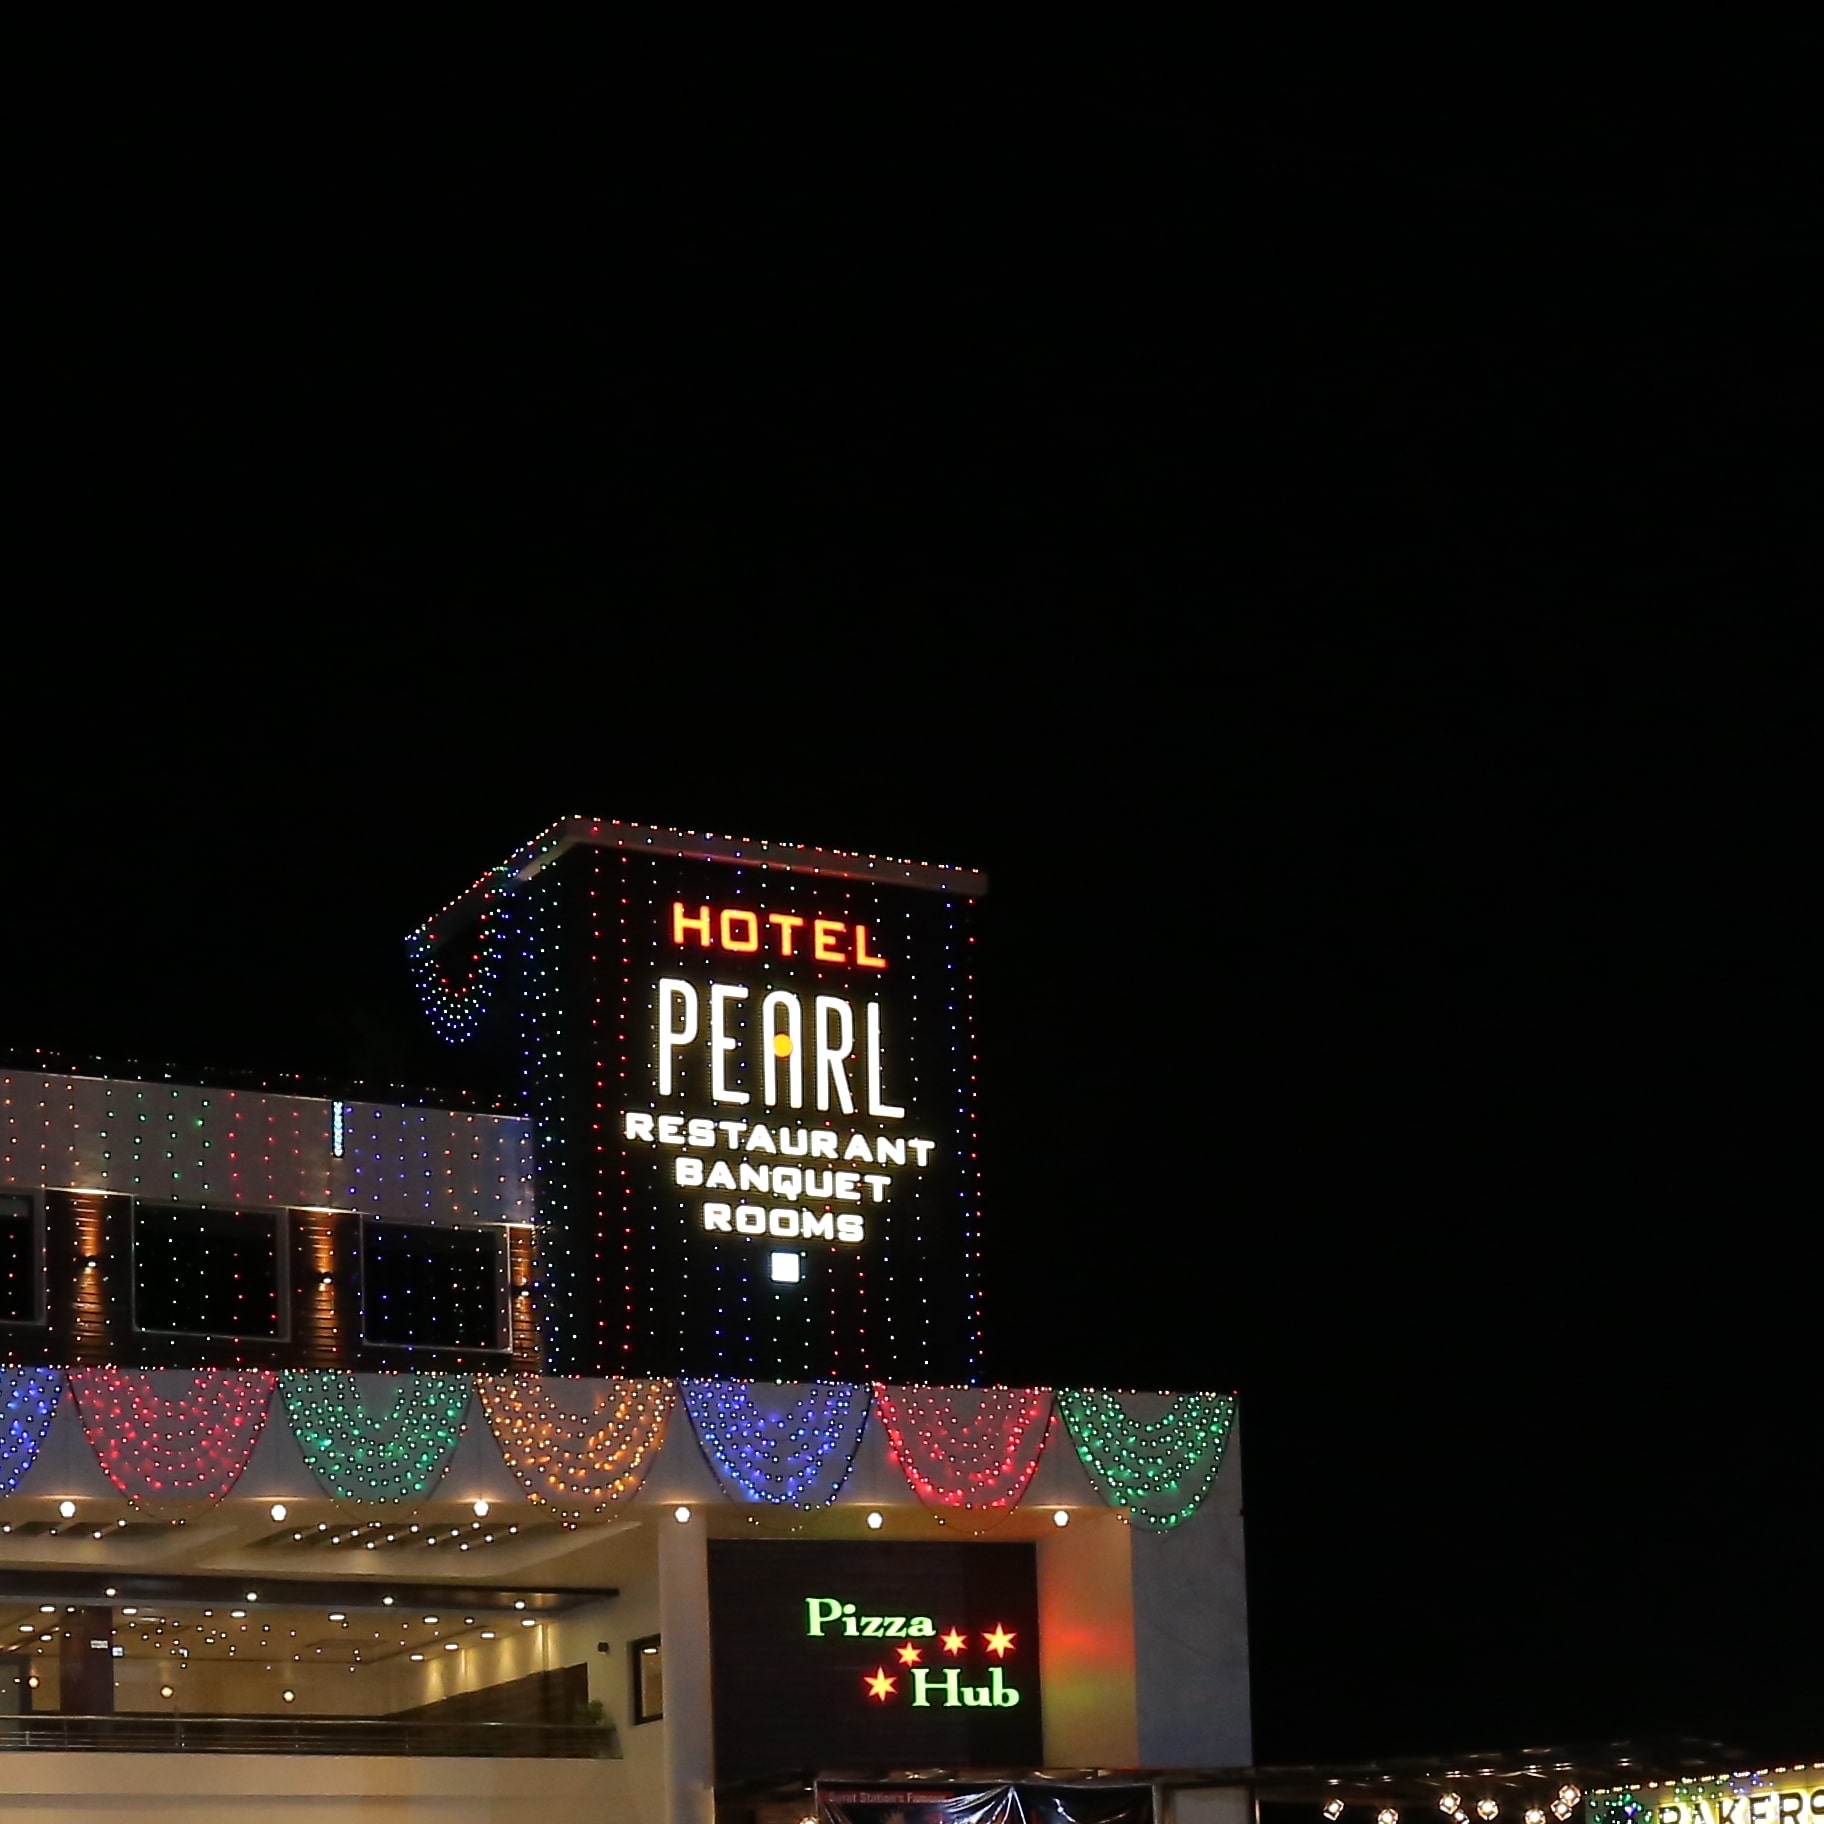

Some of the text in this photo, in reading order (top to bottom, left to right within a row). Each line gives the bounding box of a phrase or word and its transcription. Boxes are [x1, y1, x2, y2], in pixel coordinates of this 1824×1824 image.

[672, 901, 888, 968] HOTEL
[657, 977, 906, 1119] PEARL
[625, 1111, 936, 1168] RESTAURANT
[675, 1156, 892, 1203] BANQUET
[702, 1202, 865, 1243] ROOMS
[806, 1597, 937, 1638] Pizza
[911, 1667, 1020, 1708] Hub
